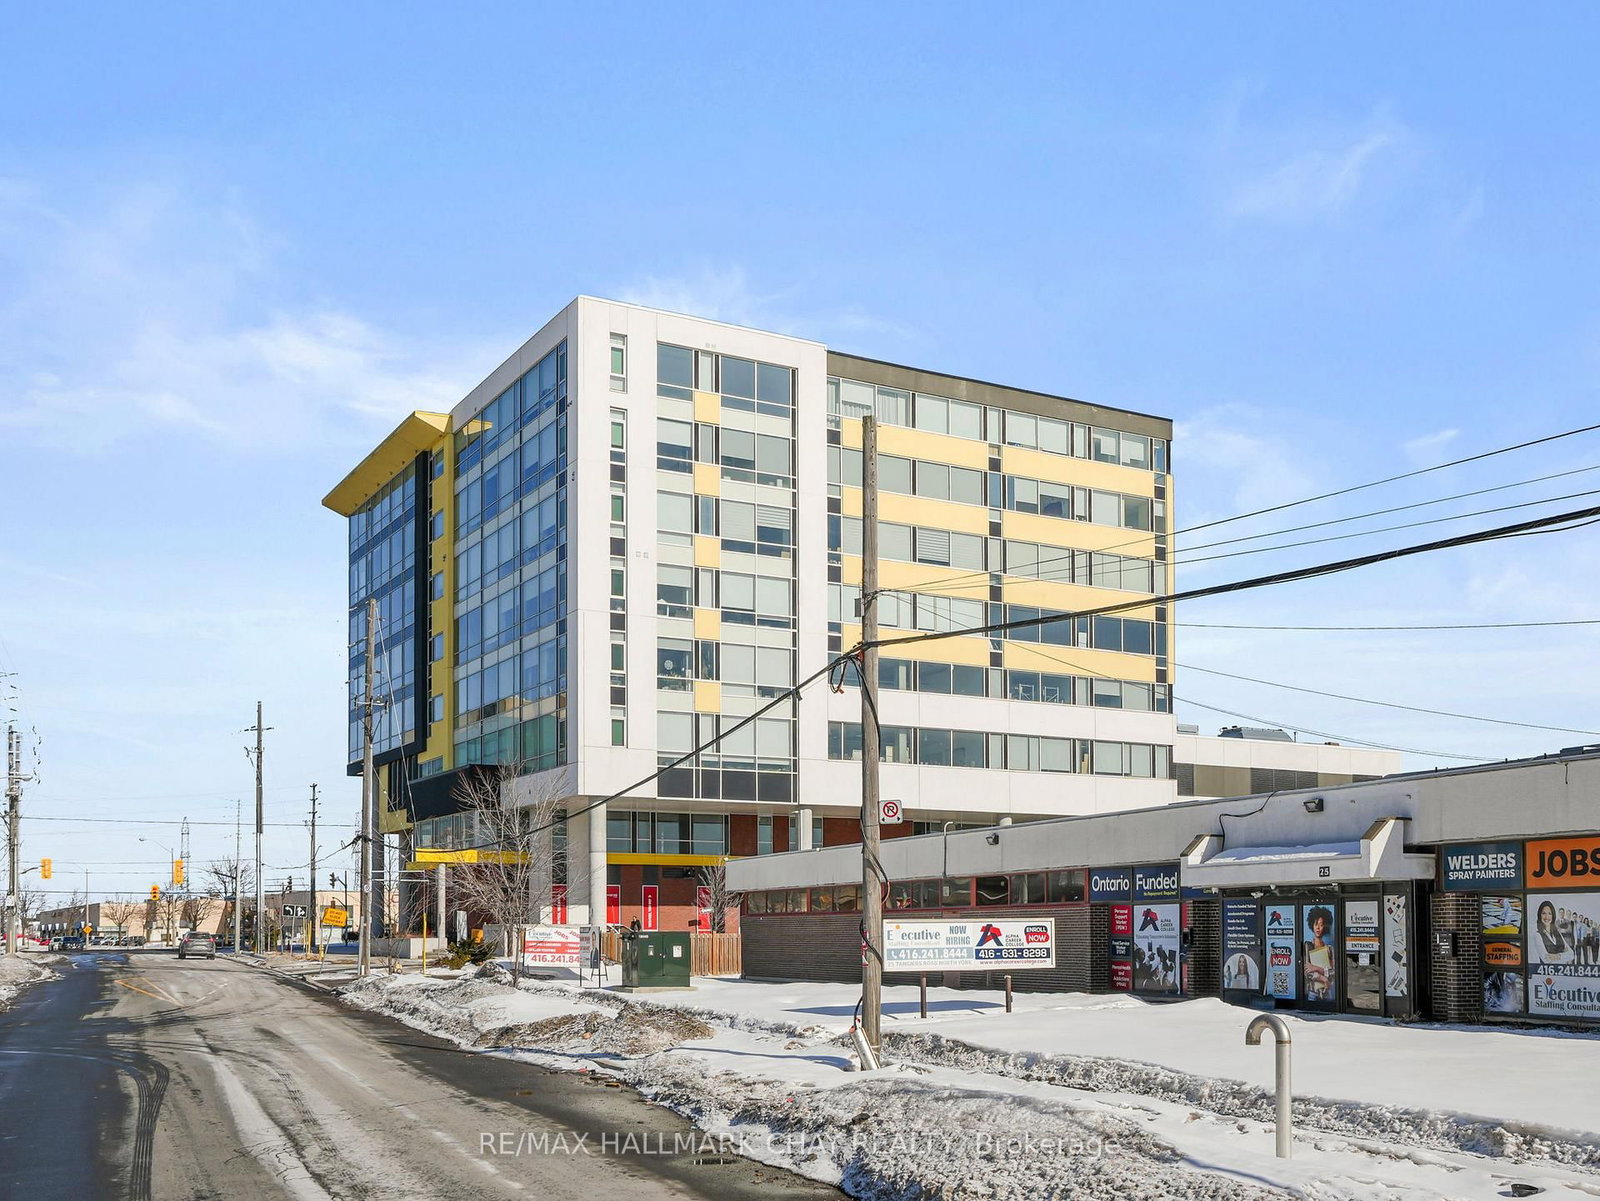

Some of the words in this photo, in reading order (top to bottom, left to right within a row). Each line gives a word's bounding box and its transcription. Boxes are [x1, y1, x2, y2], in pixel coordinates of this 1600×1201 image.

[1448, 853, 1516, 871] WELDERS
[1320, 868, 1329, 876] 25
[1449, 871, 1475, 880] SPRAY
[1476, 869, 1516, 879] PAINTERS
[1092, 875, 1130, 892] Ontario
[1136, 872, 1178, 890] Funded
[887, 926, 941, 940] Eecutive
[949, 926, 966, 934] NOW
[946, 936, 970, 946] HIRING
[898, 948, 968, 959] 416.241.8444
[1537, 965, 1600, 976] 416.241.844
[1536, 1000, 1564, 1011] Staffing
